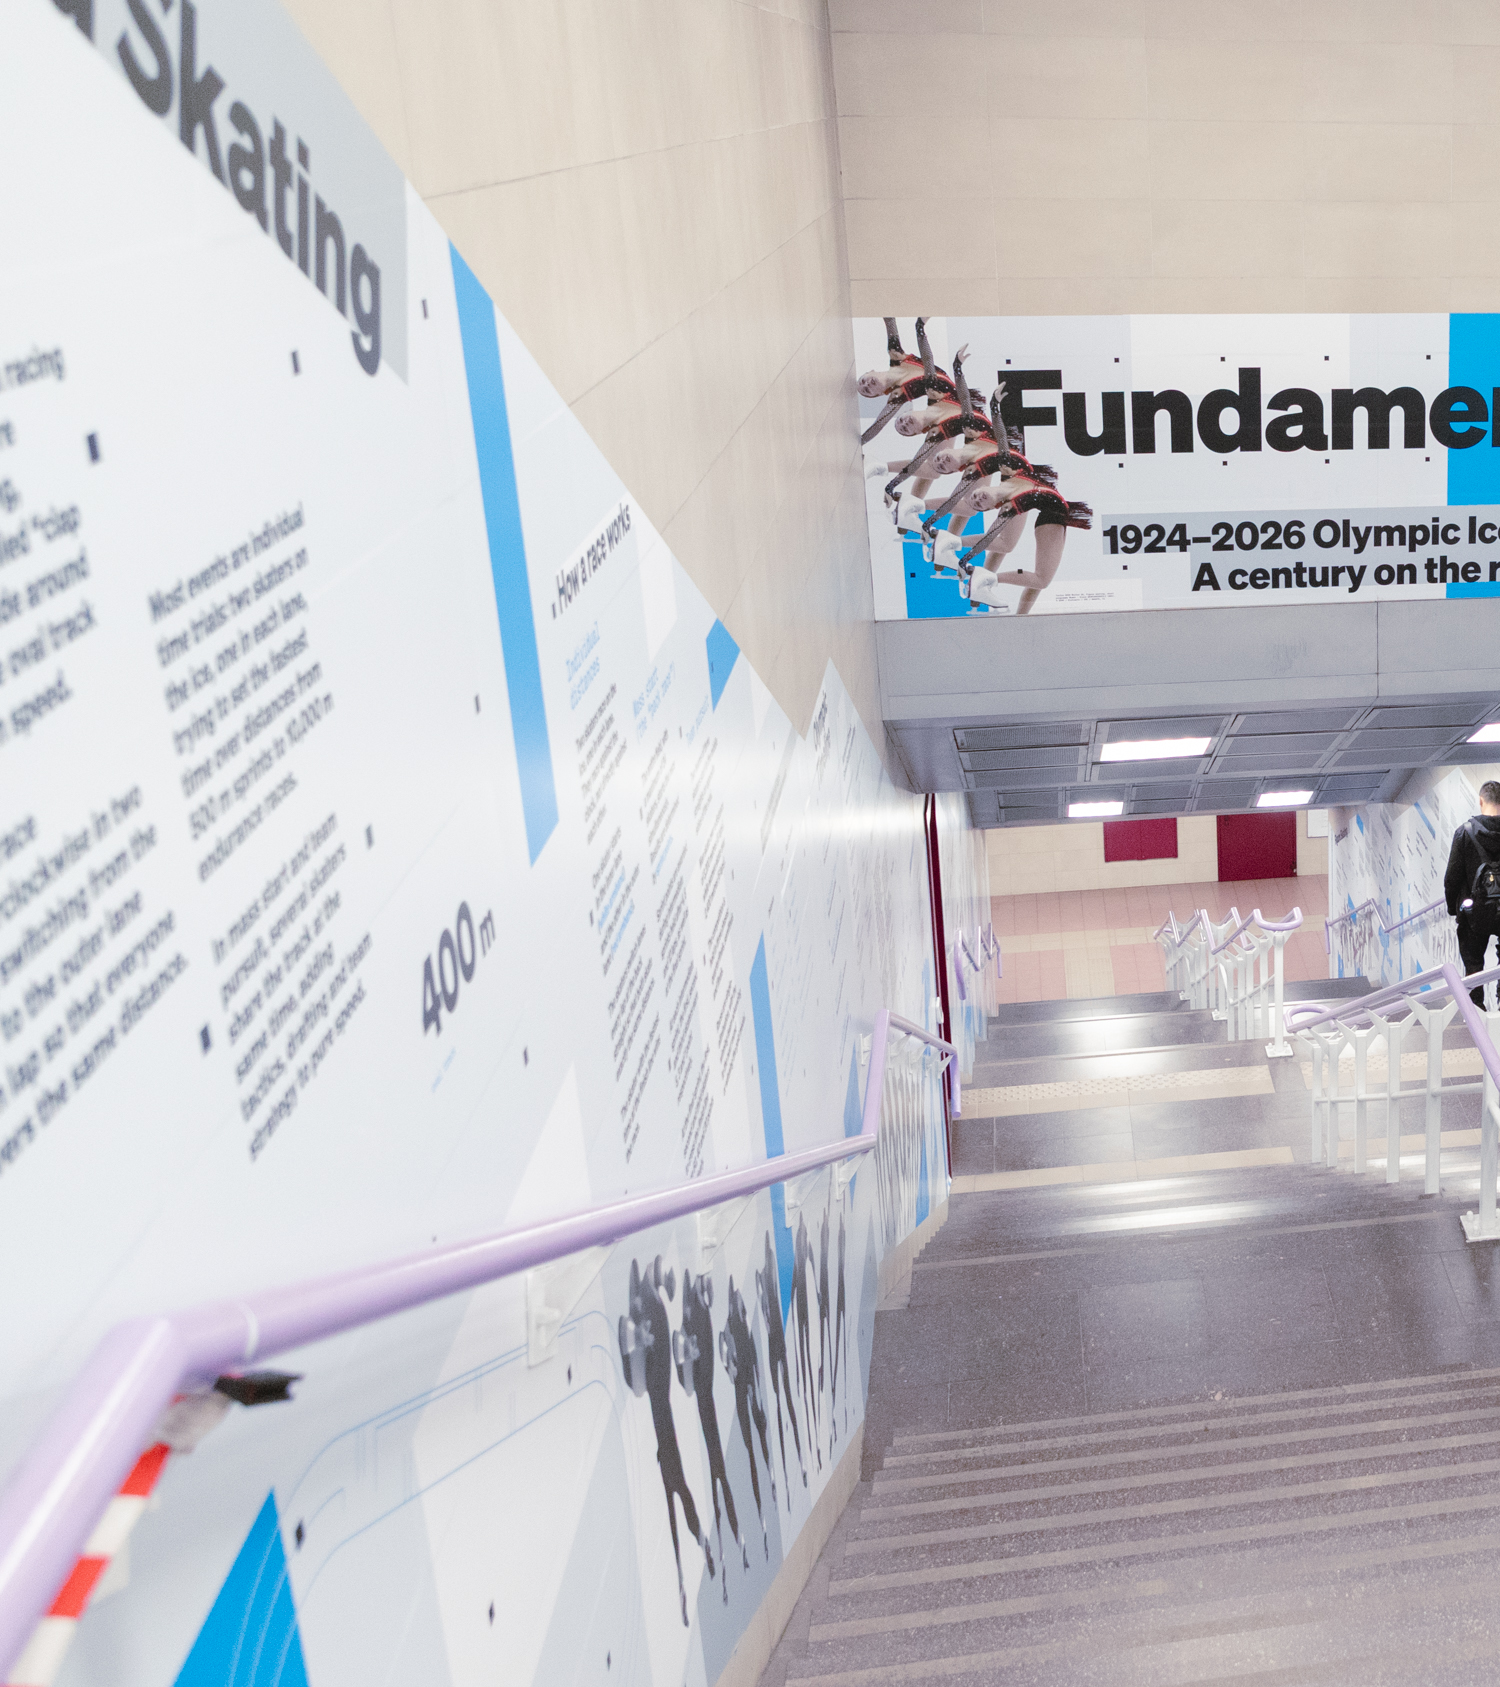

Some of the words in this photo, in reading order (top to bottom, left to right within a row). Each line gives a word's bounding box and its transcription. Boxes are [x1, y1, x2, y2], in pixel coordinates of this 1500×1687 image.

[117, 0, 382, 376] Skating
[556, 569, 580, 615] How
[580, 555, 588, 586] a
[587, 532, 607, 580] race
[607, 502, 631, 553] works
[1192, 562, 1220, 591] A
[1229, 561, 1366, 592] century
[1374, 562, 1417, 585] on
[1424, 556, 1490, 583] the
[1313, 517, 1460, 553] Olympic
[423, 900, 476, 1038] 400
[479, 908, 496, 959] m
